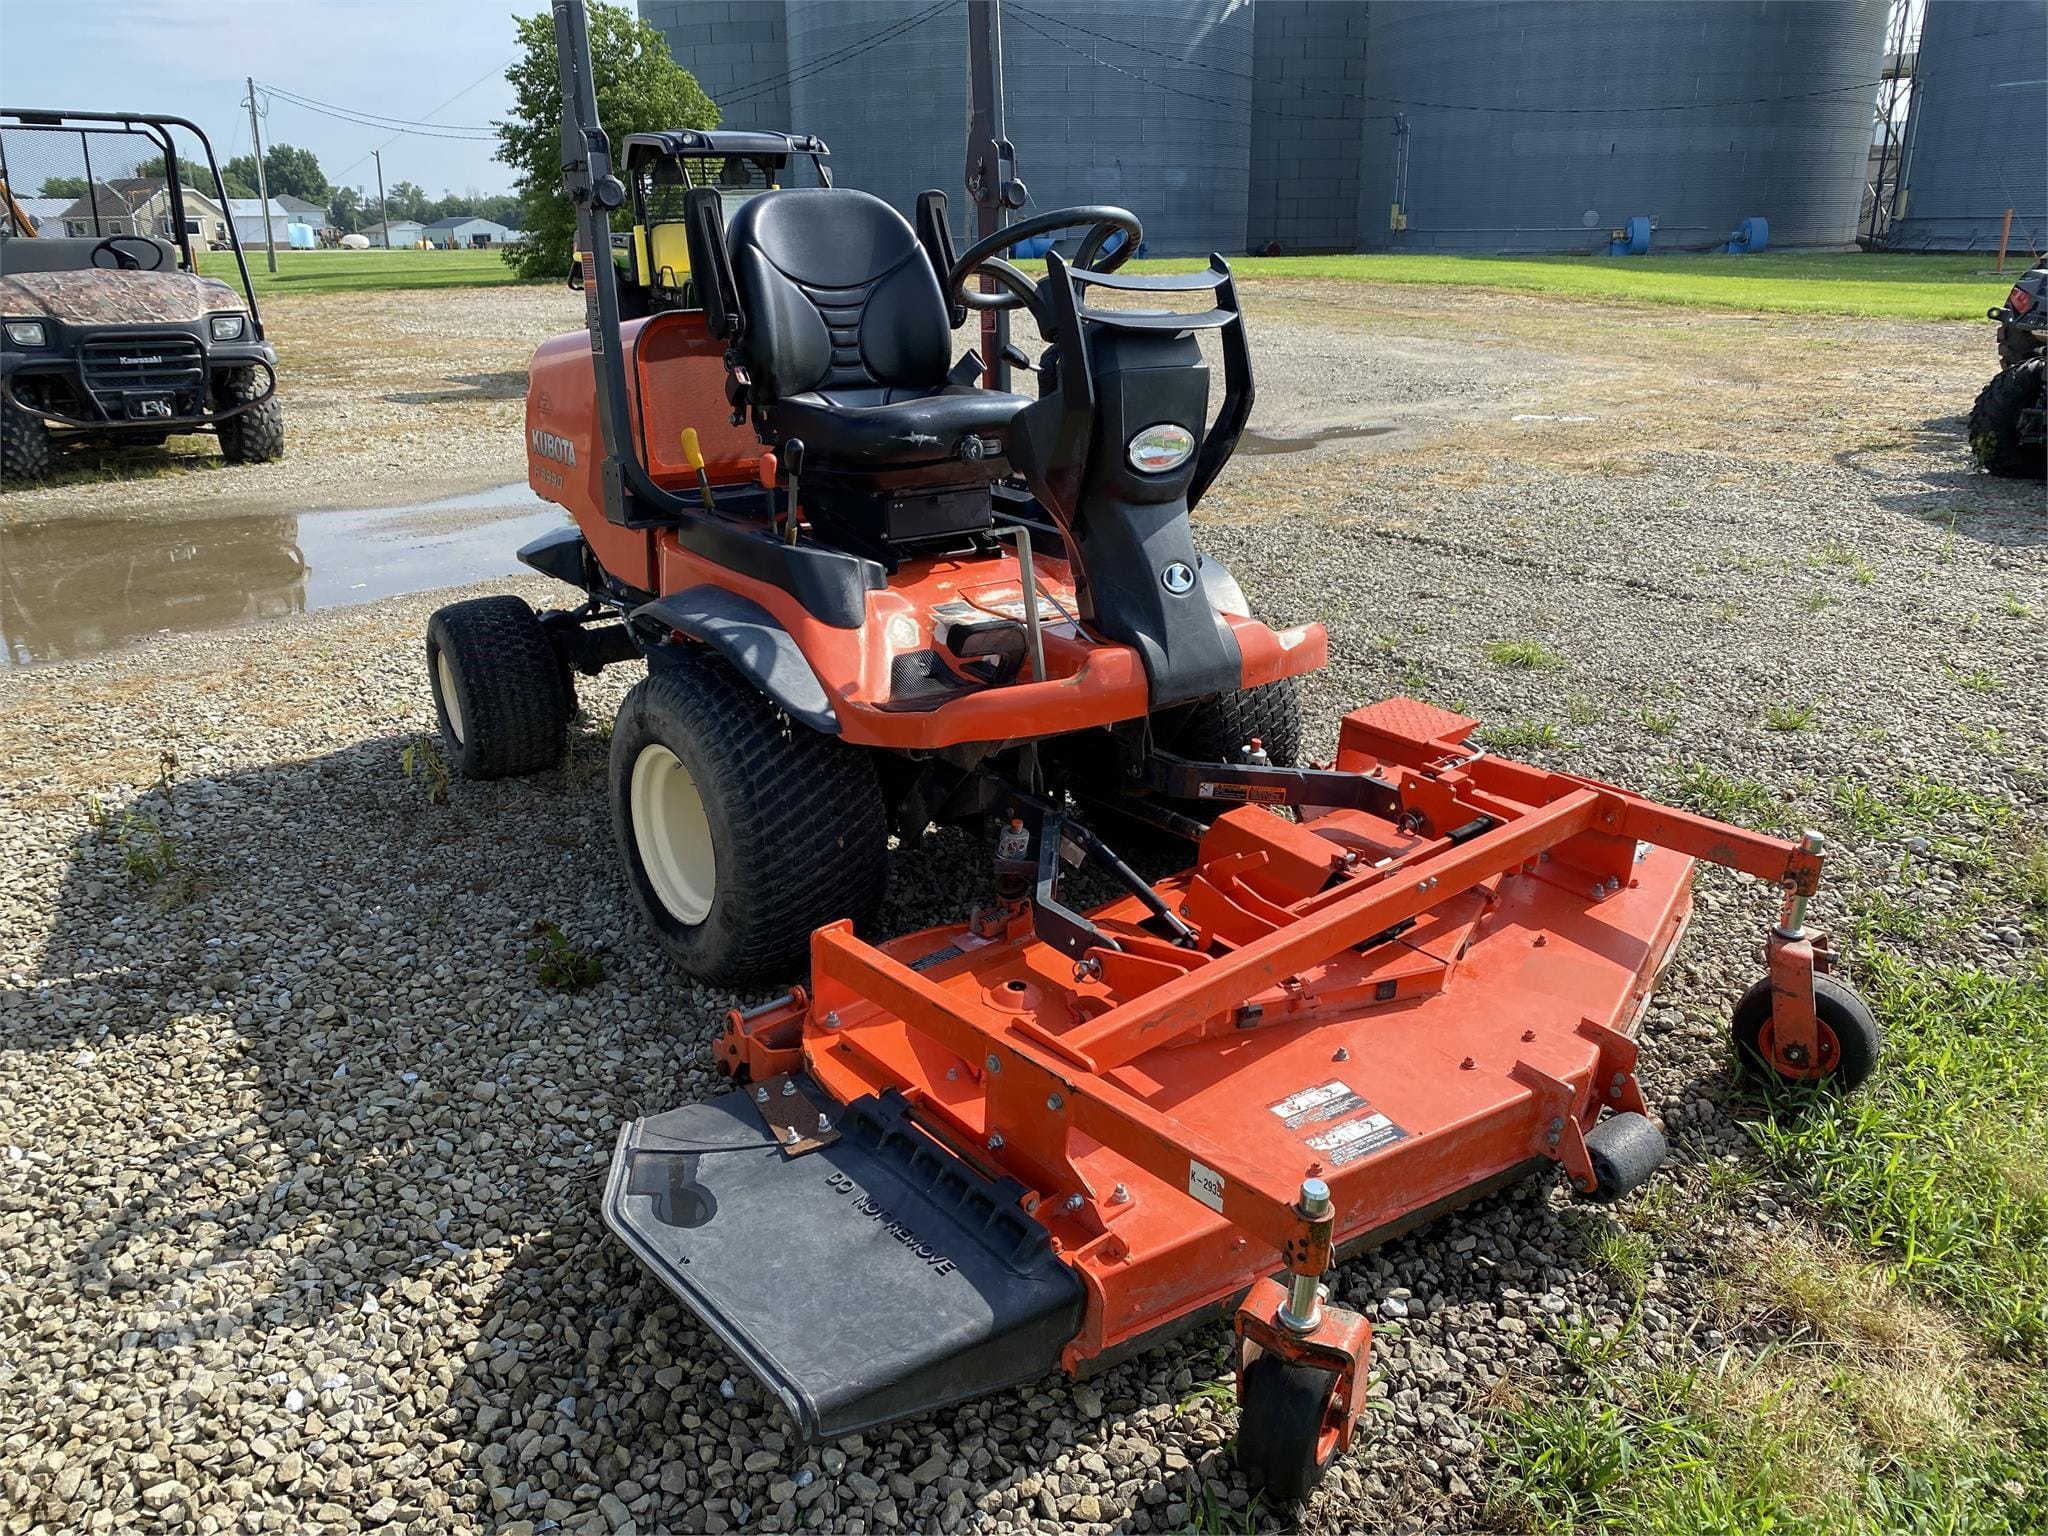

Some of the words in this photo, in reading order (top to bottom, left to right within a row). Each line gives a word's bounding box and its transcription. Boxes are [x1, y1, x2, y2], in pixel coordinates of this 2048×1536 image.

[119, 355, 162, 366] Kawasaki
[532, 428, 576, 468] KUBOTA
[825, 1172, 855, 1195] DO
[853, 1195, 891, 1222] NOT
[884, 1222, 957, 1277] REMOVE
